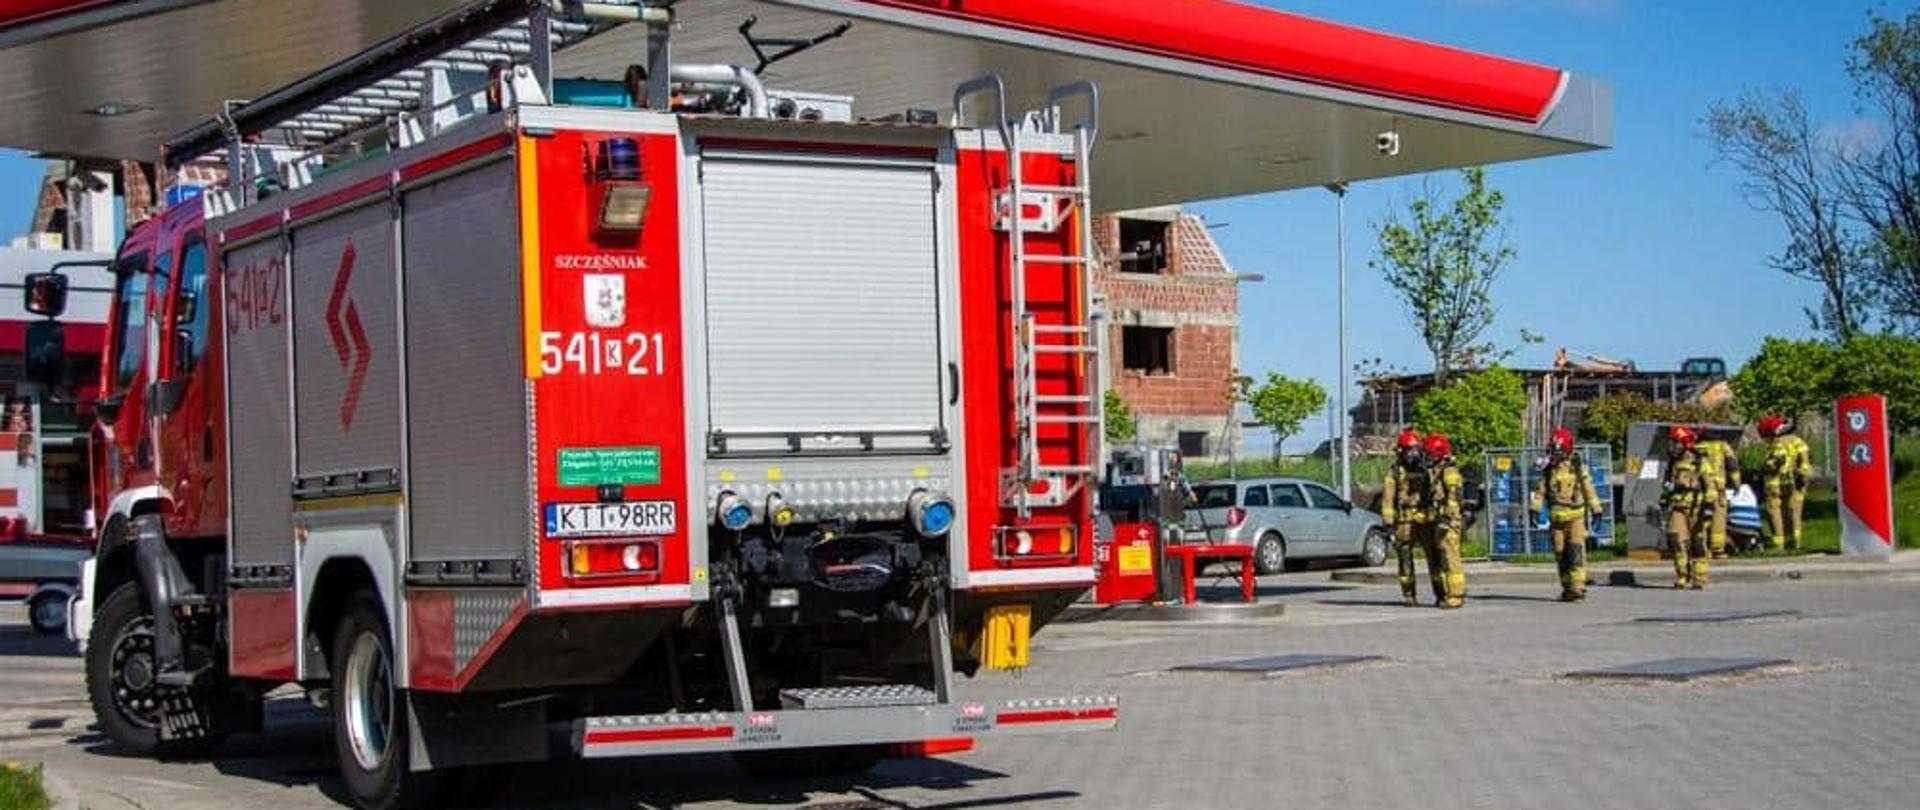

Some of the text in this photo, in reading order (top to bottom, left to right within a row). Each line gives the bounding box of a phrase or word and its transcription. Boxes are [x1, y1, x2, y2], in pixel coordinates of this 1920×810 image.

[554, 254, 648, 272] SZCZĘŚNIAK
[561, 503, 673, 529] KTT 98RR
